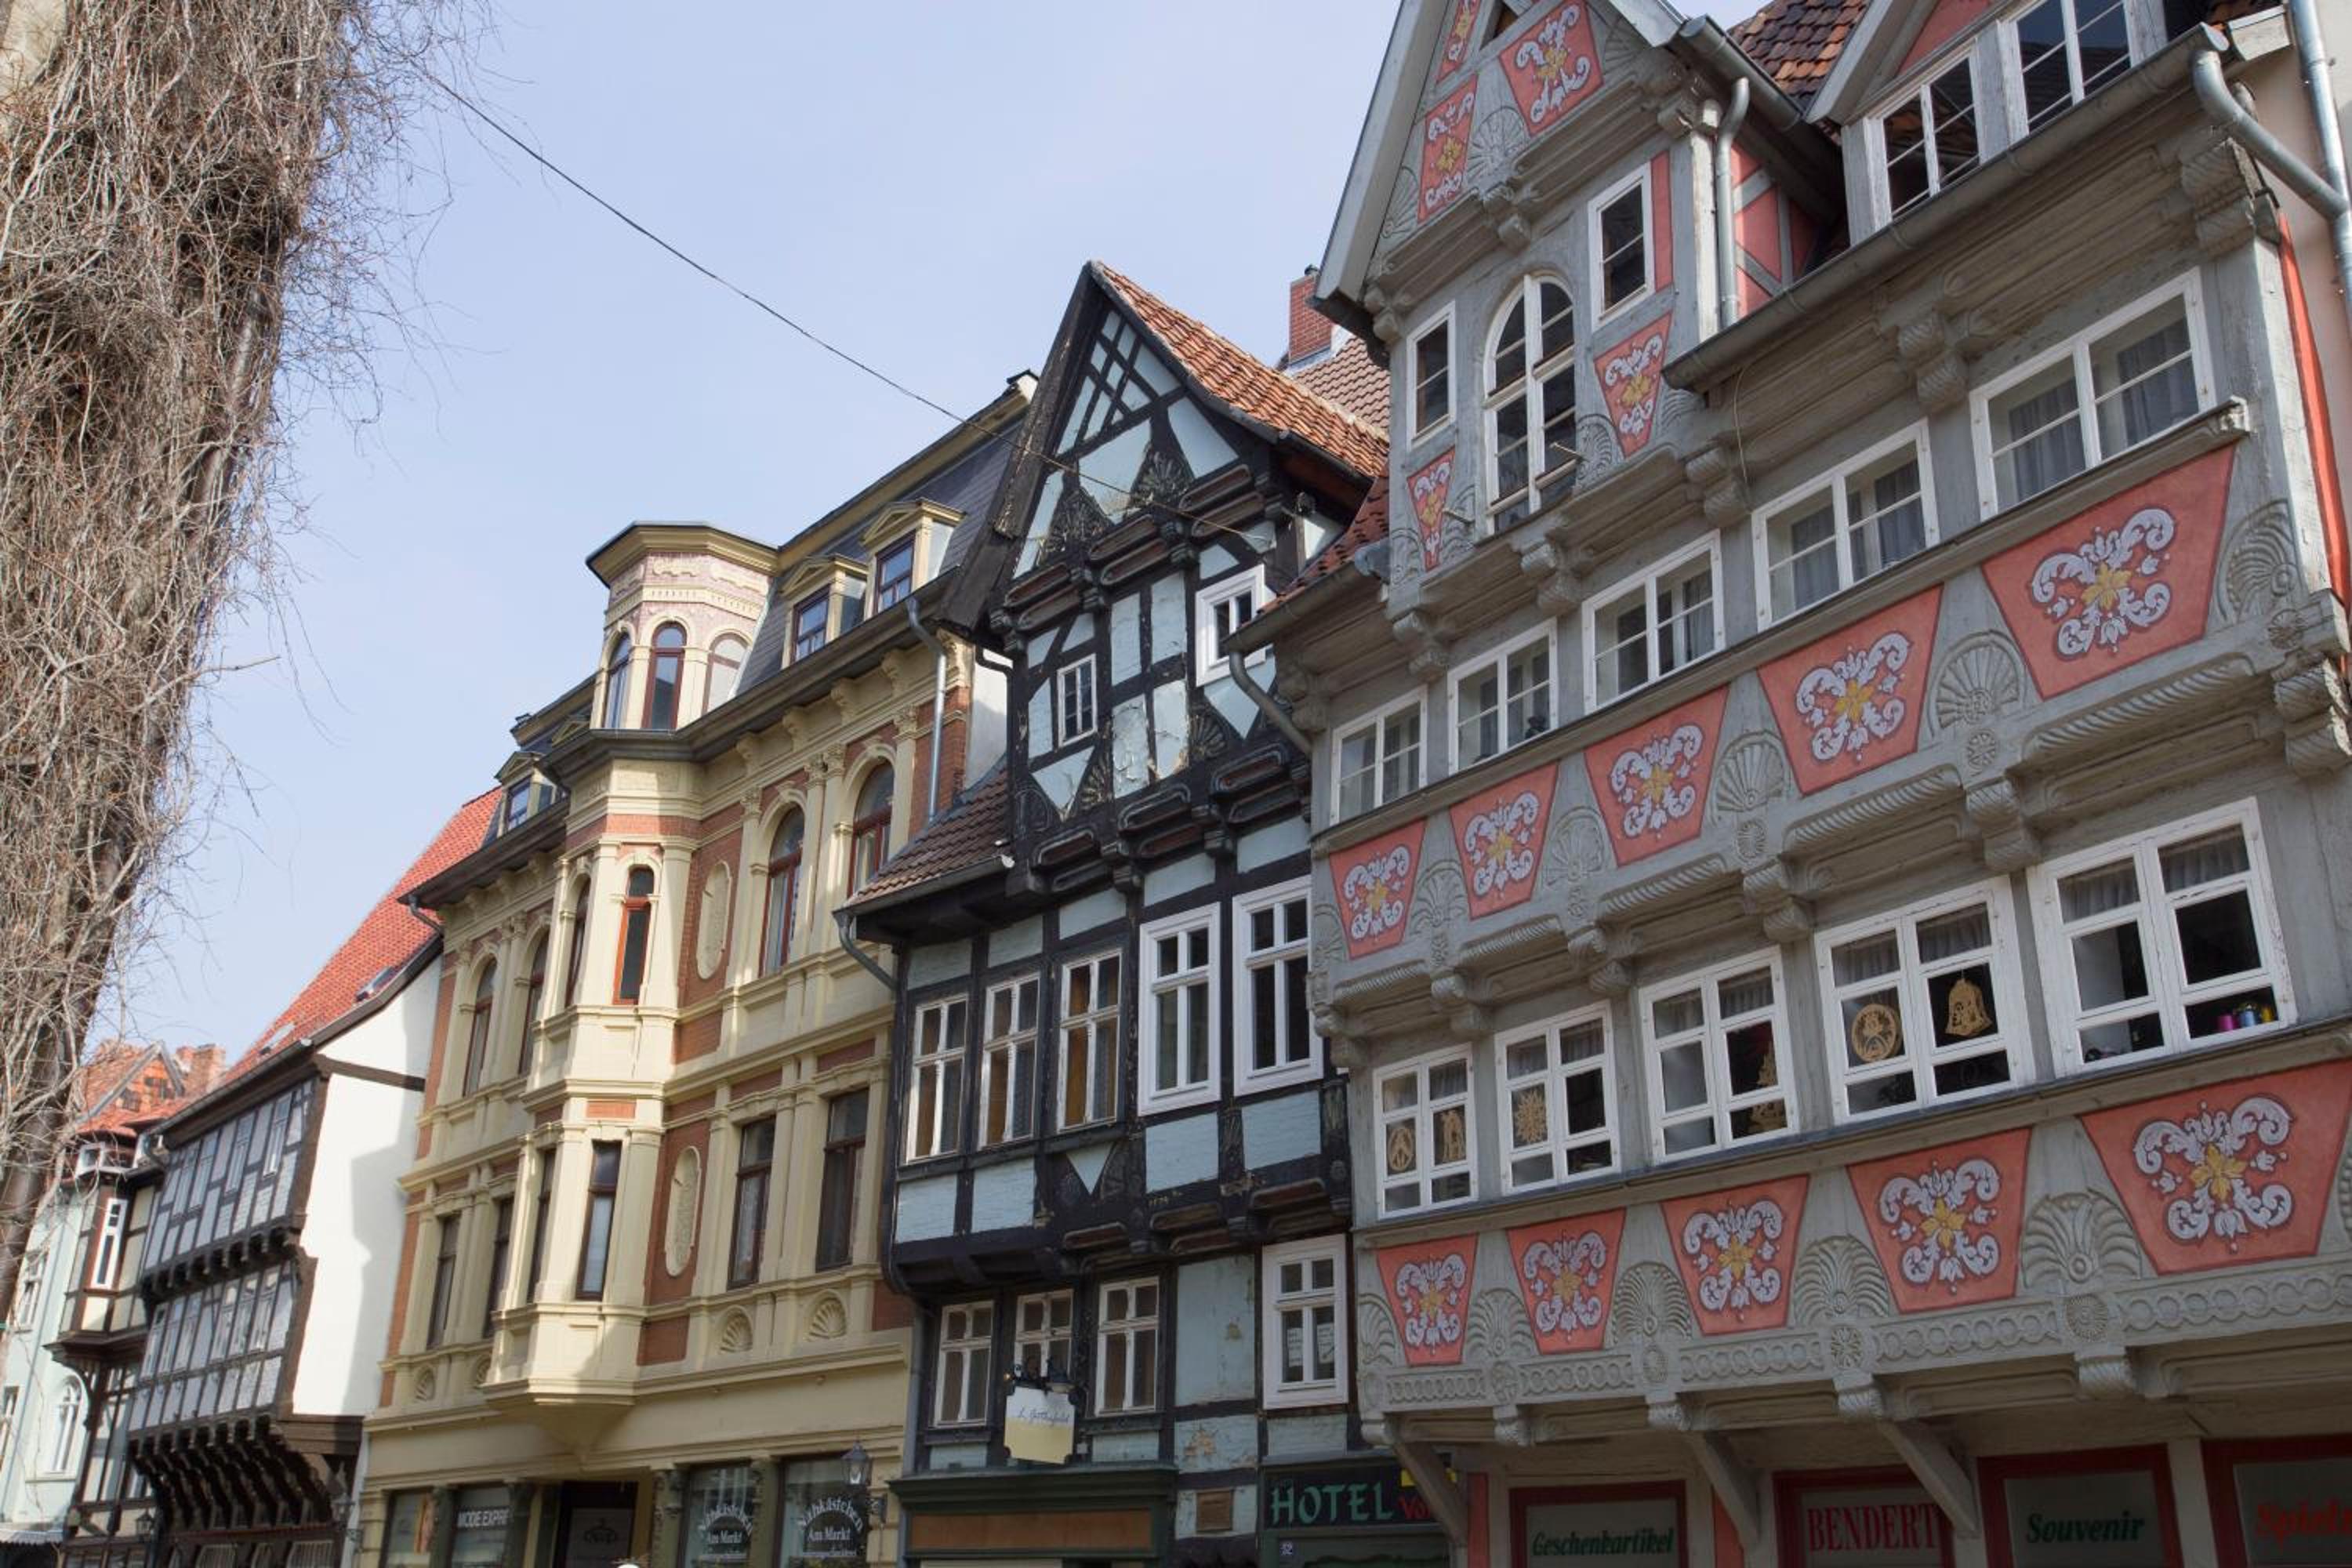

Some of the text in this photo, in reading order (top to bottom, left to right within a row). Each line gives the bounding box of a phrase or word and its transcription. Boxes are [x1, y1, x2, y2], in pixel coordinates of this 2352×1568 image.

[1271, 1481, 1392, 1525] HOTEL
[808, 1525, 850, 1542] Am Markt
[1532, 1527, 1674, 1556] Geschenkartikel
[1807, 1504, 1937, 1552] BENDERT
[2027, 1510, 2145, 1543] Souvenir
